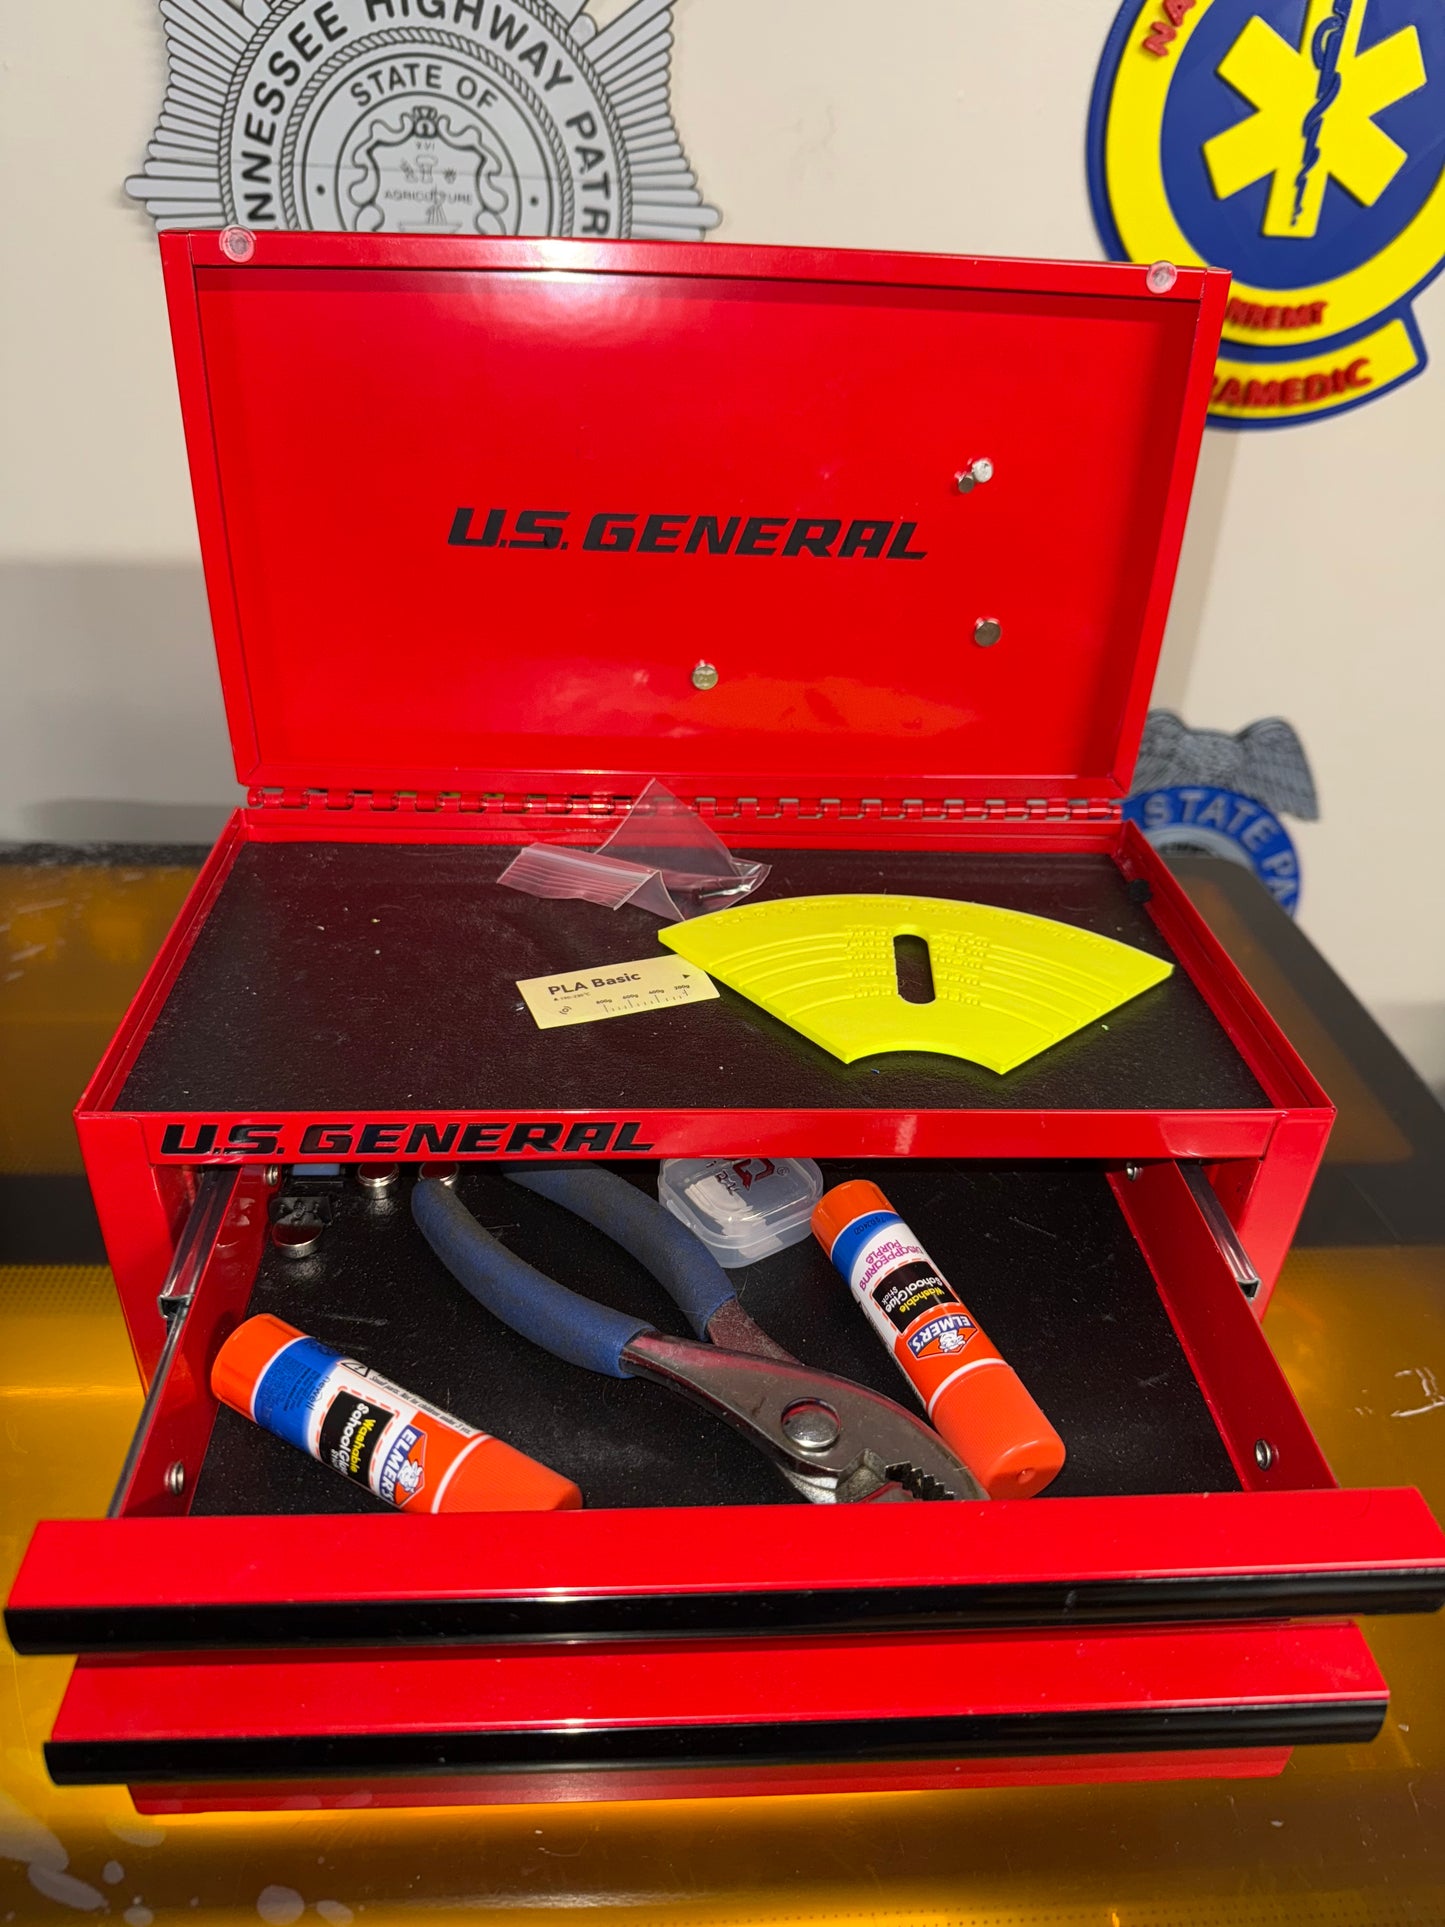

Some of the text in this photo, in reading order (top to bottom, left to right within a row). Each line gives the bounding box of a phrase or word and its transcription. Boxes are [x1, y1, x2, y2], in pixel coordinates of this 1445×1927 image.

[351, 63, 498, 109] STATE OF
[242, 1, 348, 222] NNESSEE
[365, 0, 573, 91] HIGHWAY
[1212, 357, 1373, 408] AMEDIC
[447, 507, 928, 560] U.S. GENERAL
[1143, 790, 1280, 850] STATE
[547, 973, 641, 995] PLA Basic
[160, 1121, 656, 1156] U.S. GENERAL
[881, 1286, 899, 1305] Stick
[885, 1276, 943, 1312] School Glue
[899, 1286, 945, 1312] Washable
[912, 1315, 971, 1352] ELMER'S
[338, 1402, 370, 1452] School
[349, 1418, 376, 1473] Washable
[381, 1428, 417, 1502] ELMER'S
